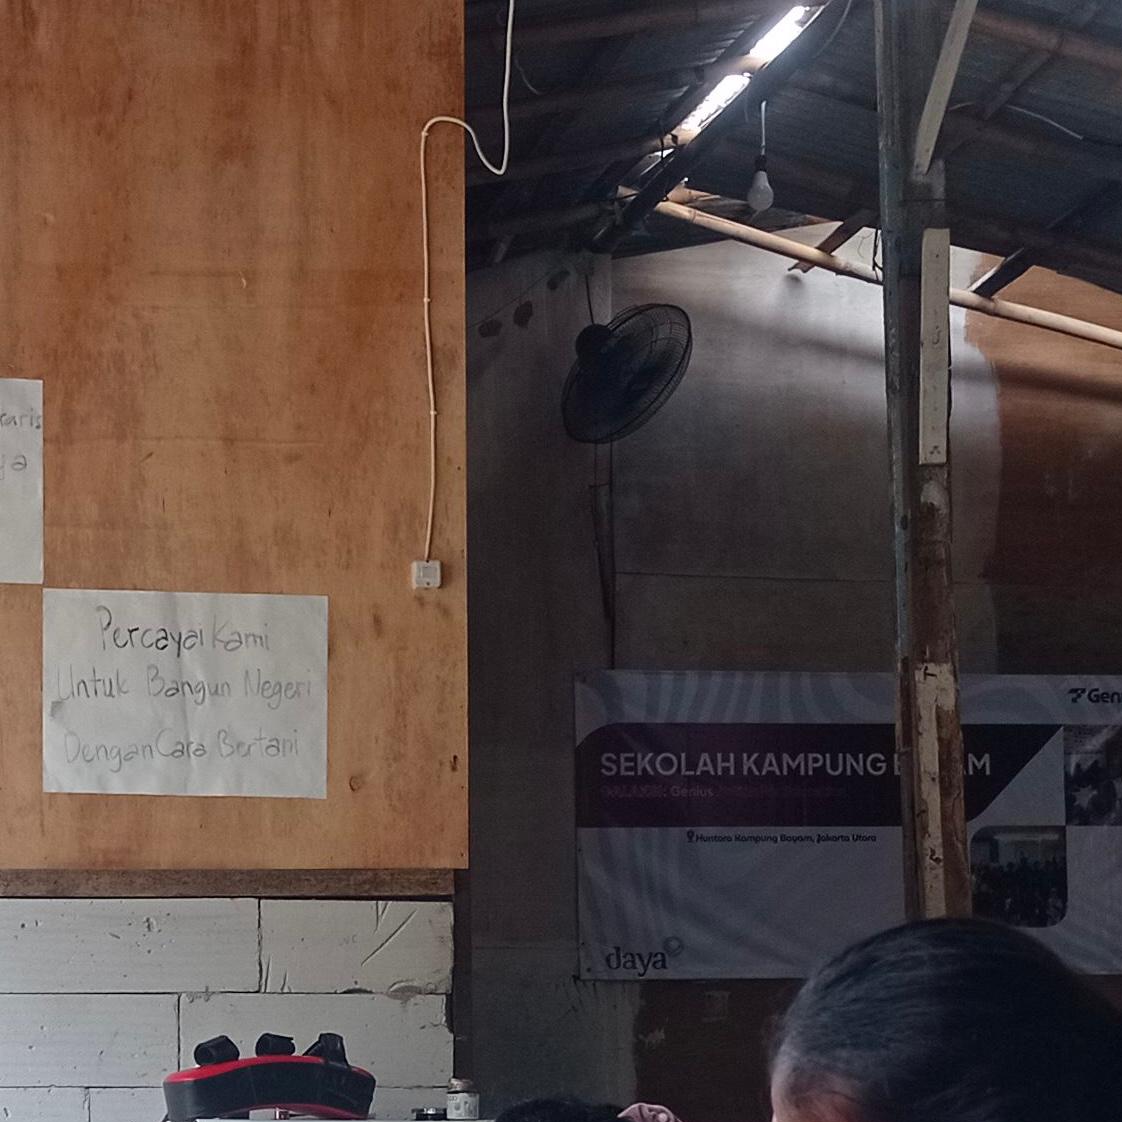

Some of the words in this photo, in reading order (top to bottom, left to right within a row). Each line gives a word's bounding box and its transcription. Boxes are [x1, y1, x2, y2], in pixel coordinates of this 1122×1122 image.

[98, 605, 204, 657] Percayai
[212, 614, 270, 652] Kami
[56, 665, 128, 701] Untuk
[146, 665, 231, 705] Bangun
[244, 669, 313, 709] Negeri
[64, 732, 154, 772] Dengan
[156, 728, 208, 759] Cara
[217, 729, 299, 759] Bertani
[600, 752, 735, 777] SEKOLAH
[742, 752, 887, 777] KAMPUNG
[606, 946, 668, 977] daya
